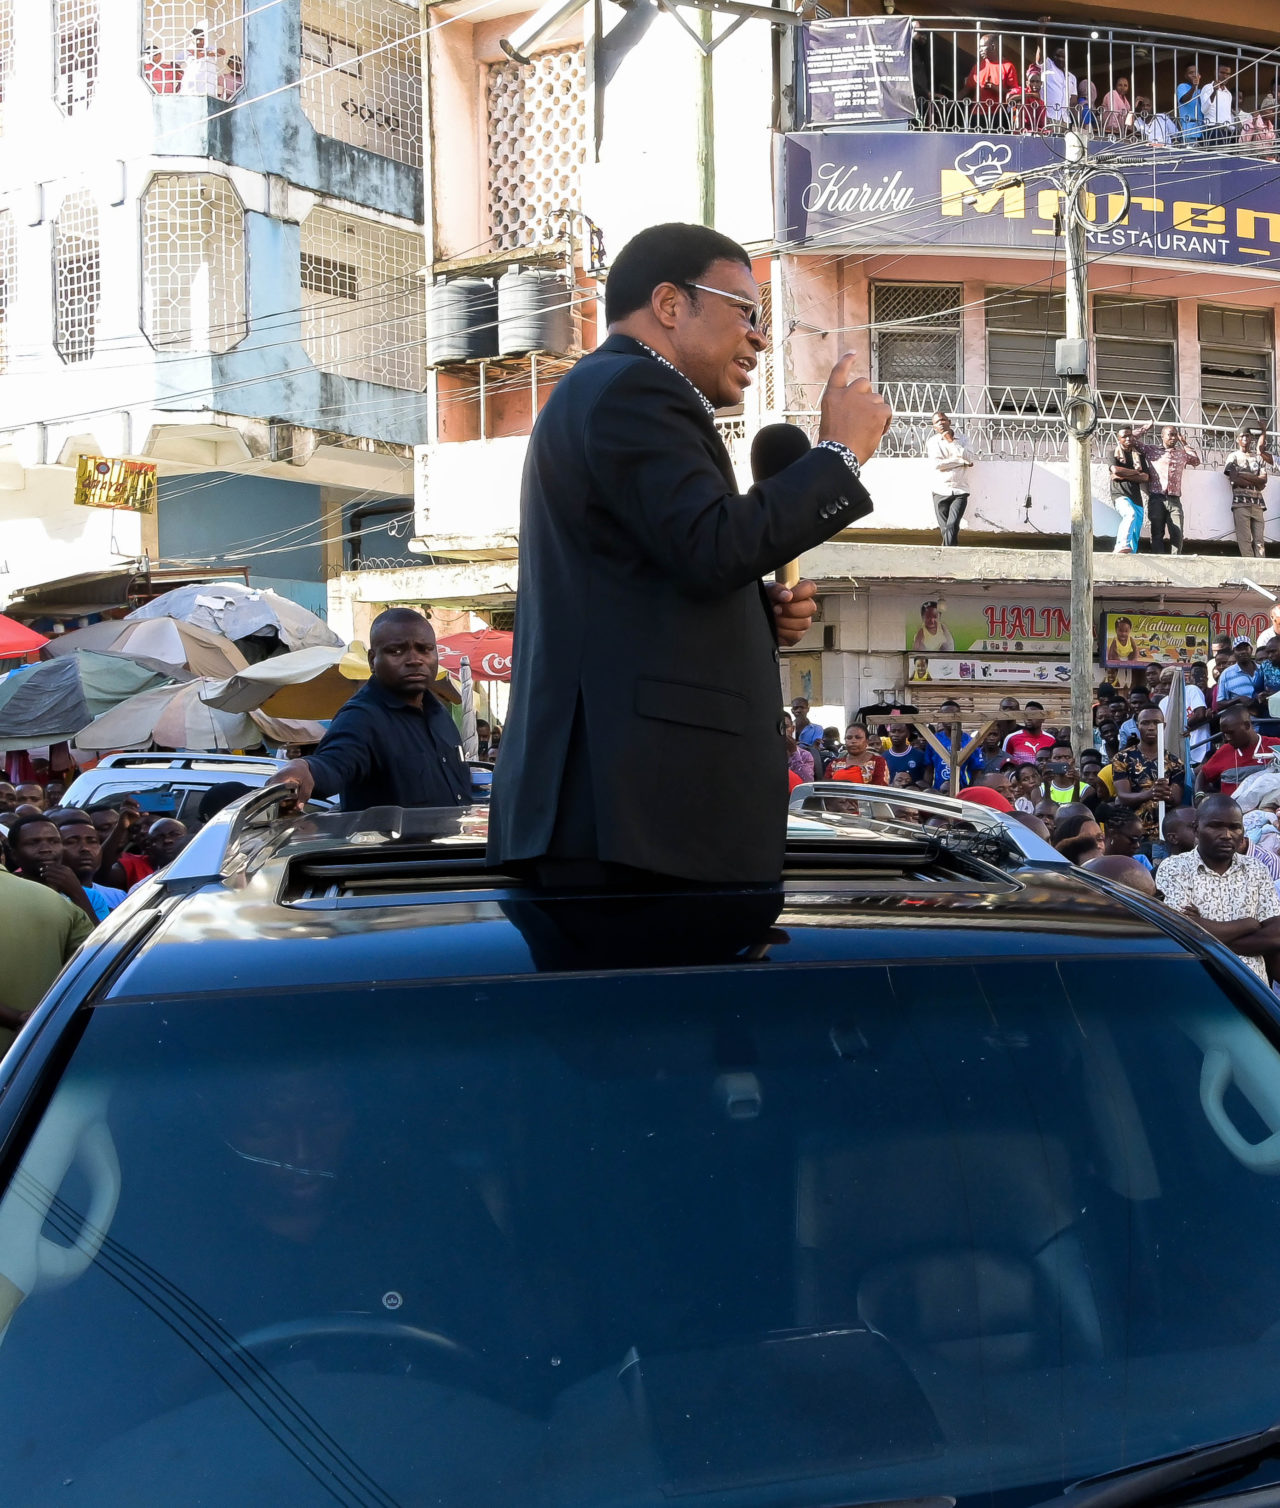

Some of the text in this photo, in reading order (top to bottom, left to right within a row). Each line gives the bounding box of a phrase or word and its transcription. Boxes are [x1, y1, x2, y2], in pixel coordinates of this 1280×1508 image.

[802, 163, 914, 212] Karibu
[1085, 229, 1230, 256] RESTAURANT
[984, 606, 1098, 640] HALIM
